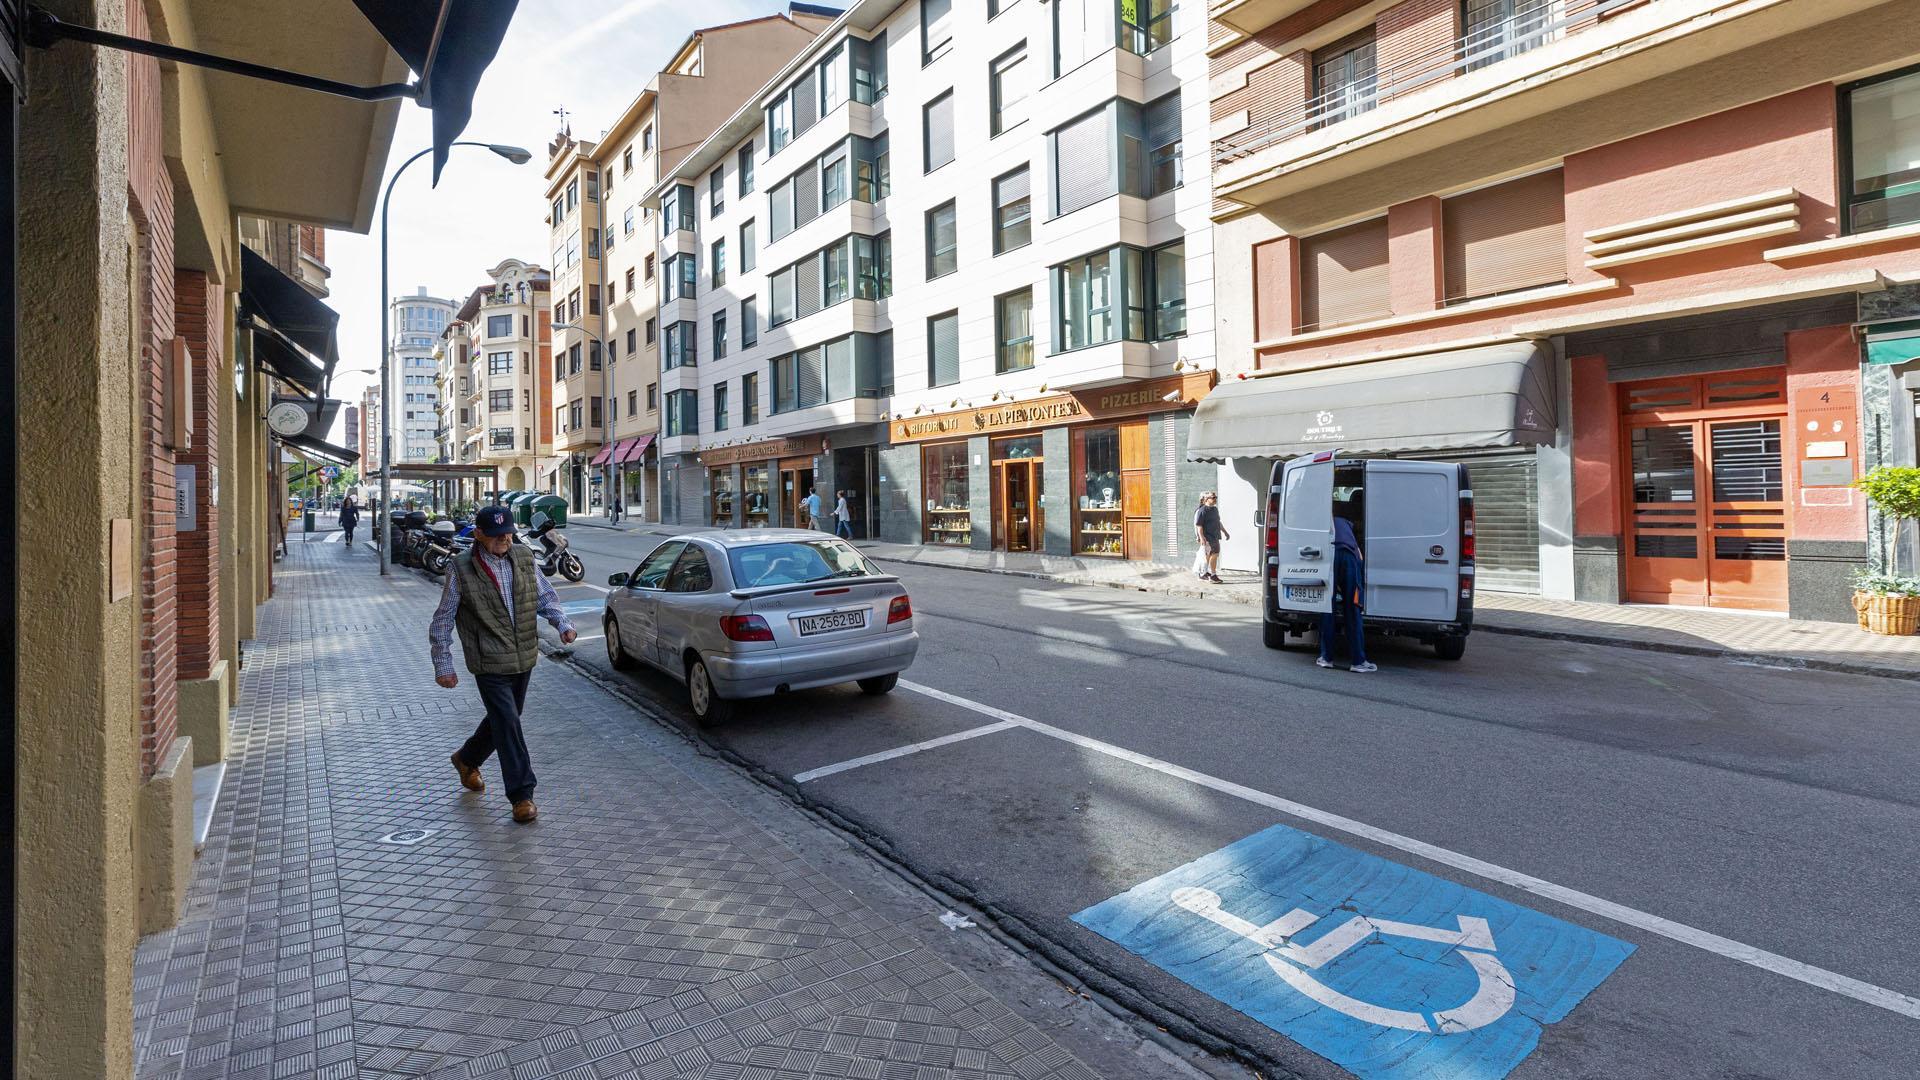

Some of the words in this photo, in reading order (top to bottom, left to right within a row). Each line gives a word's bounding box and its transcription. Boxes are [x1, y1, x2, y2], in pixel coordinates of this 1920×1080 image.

[989, 412, 1003, 427] LA
[1004, 401, 1082, 424] PIEMONTESA
[1101, 388, 1161, 409] PIZZERIE
[1820, 392, 1830, 404] 4
